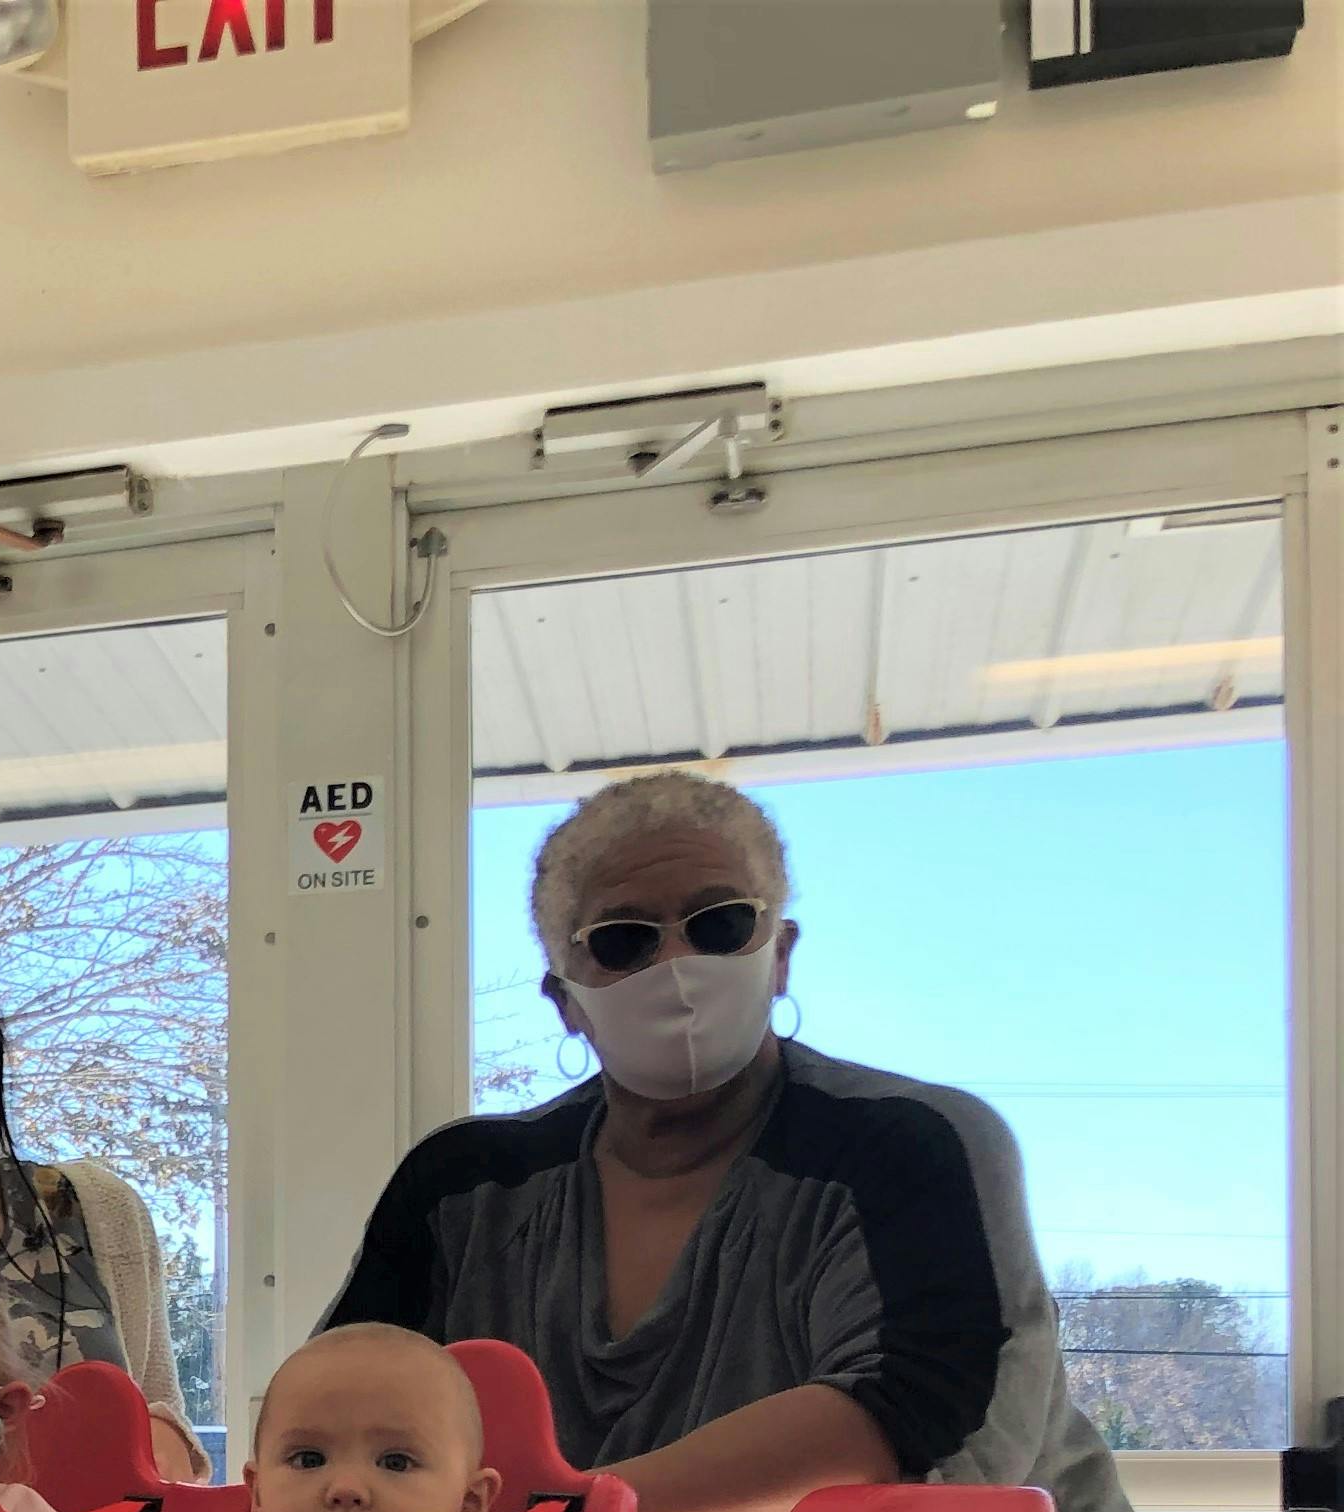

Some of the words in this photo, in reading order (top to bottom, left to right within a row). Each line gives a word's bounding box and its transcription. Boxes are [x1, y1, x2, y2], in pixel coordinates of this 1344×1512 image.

[300, 782, 374, 814] AED
[298, 873, 326, 890] ON
[331, 869, 376, 887] SITE
